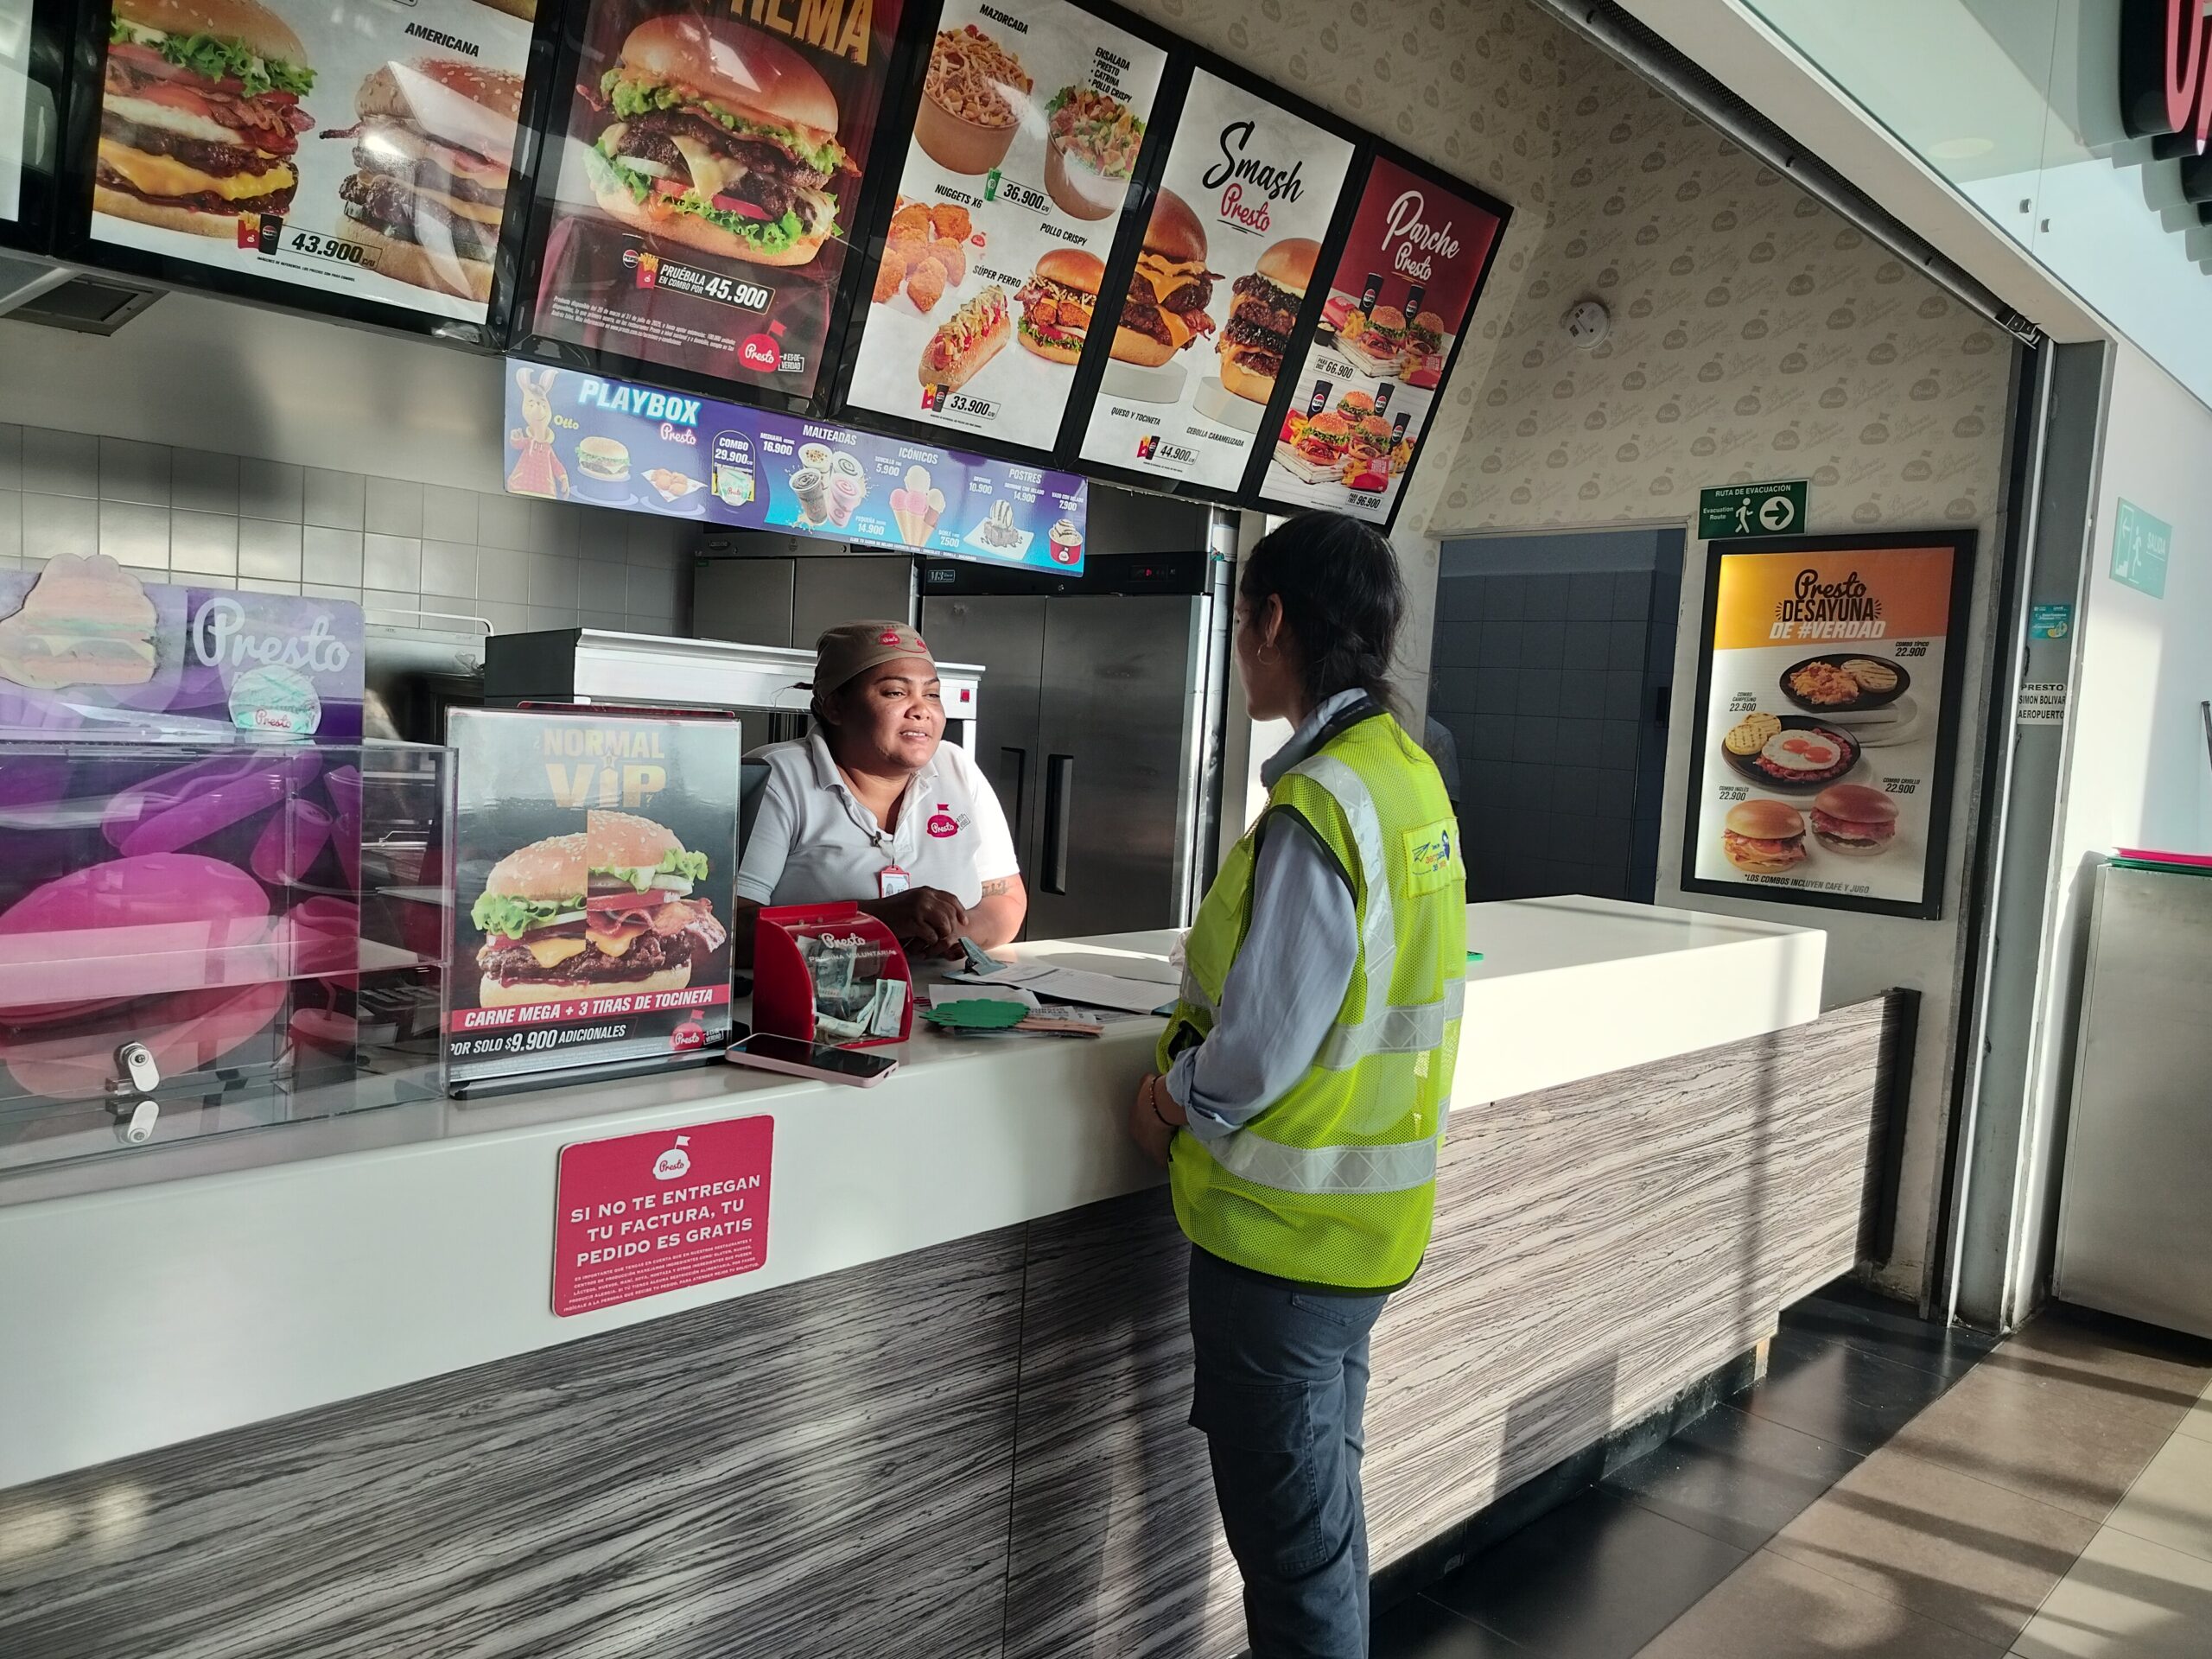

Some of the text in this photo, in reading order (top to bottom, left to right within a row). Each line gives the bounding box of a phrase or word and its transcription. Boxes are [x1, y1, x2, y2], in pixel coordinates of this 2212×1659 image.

[979, 3, 1029, 35] MAZORCADA
[404, 22, 480, 57] AMERICANA
[1095, 47, 1131, 71] ENSALADA
[1096, 60, 1121, 76] PRESTO
[1094, 70, 1120, 87] CATRINA
[1091, 79, 1133, 104] POLLO CRISPY
[1202, 121, 1304, 204] Smash
[935, 184, 983, 209] NUGGETS X6
[1003, 183, 1045, 210] 36.900
[1220, 182, 1270, 232] Presto
[1381, 189, 1460, 259] Parche
[1039, 223, 1088, 247] POLLO CRISPY
[291, 232, 364, 264] 43.900
[1394, 242, 1432, 282] Presto
[660, 264, 705, 286] PRUÉBALA
[973, 264, 1022, 288] SÚPER PERRO
[668, 278, 690, 290] COMBO
[690, 284, 704, 294] POR
[705, 276, 768, 309] 45.900
[745, 343, 775, 365] Presto
[1325, 361, 1354, 379] 66.900
[578, 379, 702, 425] PLAYBOX
[950, 396, 990, 416] 33.900
[554, 414, 579, 430] Otto
[1111, 407, 1129, 418] QUESO
[1135, 413, 1161, 426] TOCINETA
[660, 423, 696, 445] Presto
[803, 424, 857, 447] MALTEADAS
[1186, 426, 1245, 448] CEBOLLA CARAMELIZADA
[719, 437, 749, 451] COMBO
[763, 441, 793, 456] 16.900
[1160, 444, 1191, 462] 44.900
[715, 448, 748, 465] 29.900
[899, 447, 938, 465] ICÓNICOS
[876, 464, 899, 476] 5.900
[1009, 468, 1042, 484] POSTRES
[969, 482, 992, 494] 10.900
[1014, 491, 1036, 504] 14.900
[1745, 484, 1791, 494] EVACUACIÓN
[1357, 496, 1381, 509] 96.900
[858, 523, 885, 536] 14.900
[1795, 569, 1866, 600] Presto
[1783, 598, 1874, 622] DESAYUNA
[193, 597, 350, 672] Presto
[1769, 620, 1886, 639] DE #VERDAD
[1895, 647, 1927, 657] 22.900
[1729, 702, 1757, 712] 22.900
[2018, 696, 2066, 704] SIMON BOLIVAR
[255, 709, 291, 728] Presto
[2018, 710, 2064, 719] AEROPUERTO
[1719, 791, 1746, 801] 22.900
[1885, 784, 1916, 794] 22.900
[931, 822, 955, 834] Presto
[1760, 875, 1789, 886] COMBOS
[1790, 879, 1823, 888] INCLUYEN
[1824, 881, 1842, 891] CAFÉ
[1850, 885, 1870, 893] JUGO
[821, 932, 866, 949] Presto
[465, 988, 714, 1027] CARNE MEGA + 3 TIRAS DE TOCINETA
[473, 1038, 503, 1053] SOLO
[505, 1029, 558, 1052] $9.900
[558, 1025, 626, 1043] ADICIONALES
[675, 1032, 700, 1046] Presto
[659, 1159, 684, 1173] Presto
[570, 1174, 761, 1223] SI NO TE ENTREGAN
[587, 1198, 745, 1243] TU FACTURA, TU
[576, 1218, 753, 1267] PEDIDO ES GRATIS
